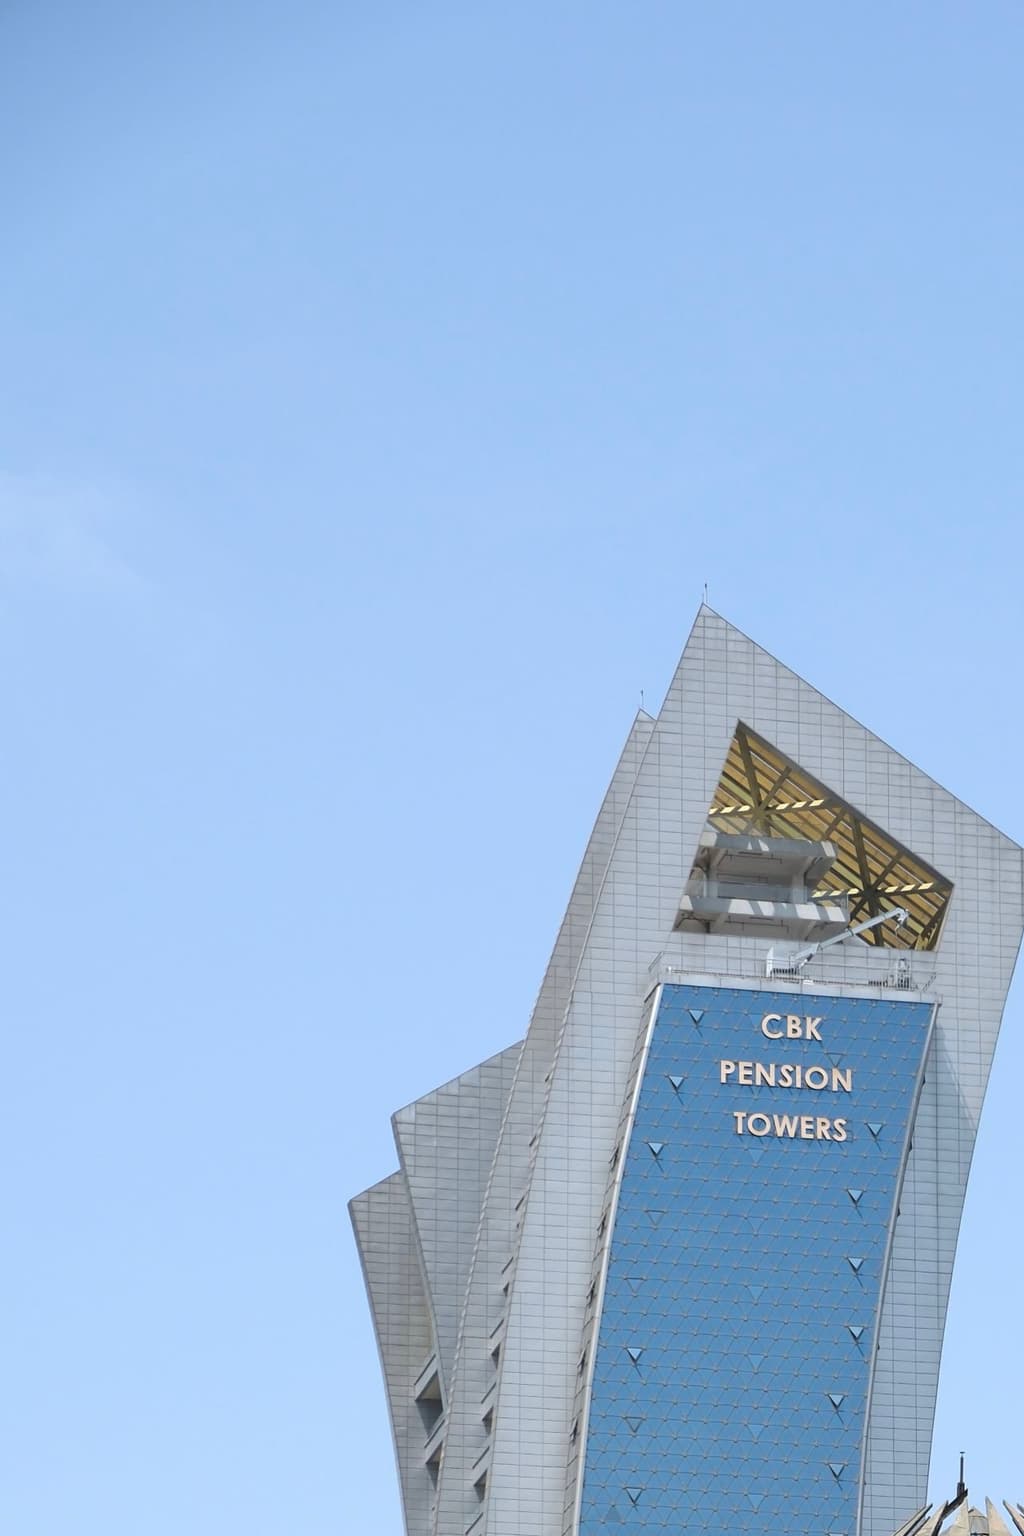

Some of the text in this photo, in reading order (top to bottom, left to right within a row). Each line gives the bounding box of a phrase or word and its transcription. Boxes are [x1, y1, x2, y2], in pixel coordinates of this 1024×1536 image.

[761, 1013, 822, 1041] CBK
[720, 1060, 852, 1092] PENSION
[733, 1111, 848, 1142] TOWERS
